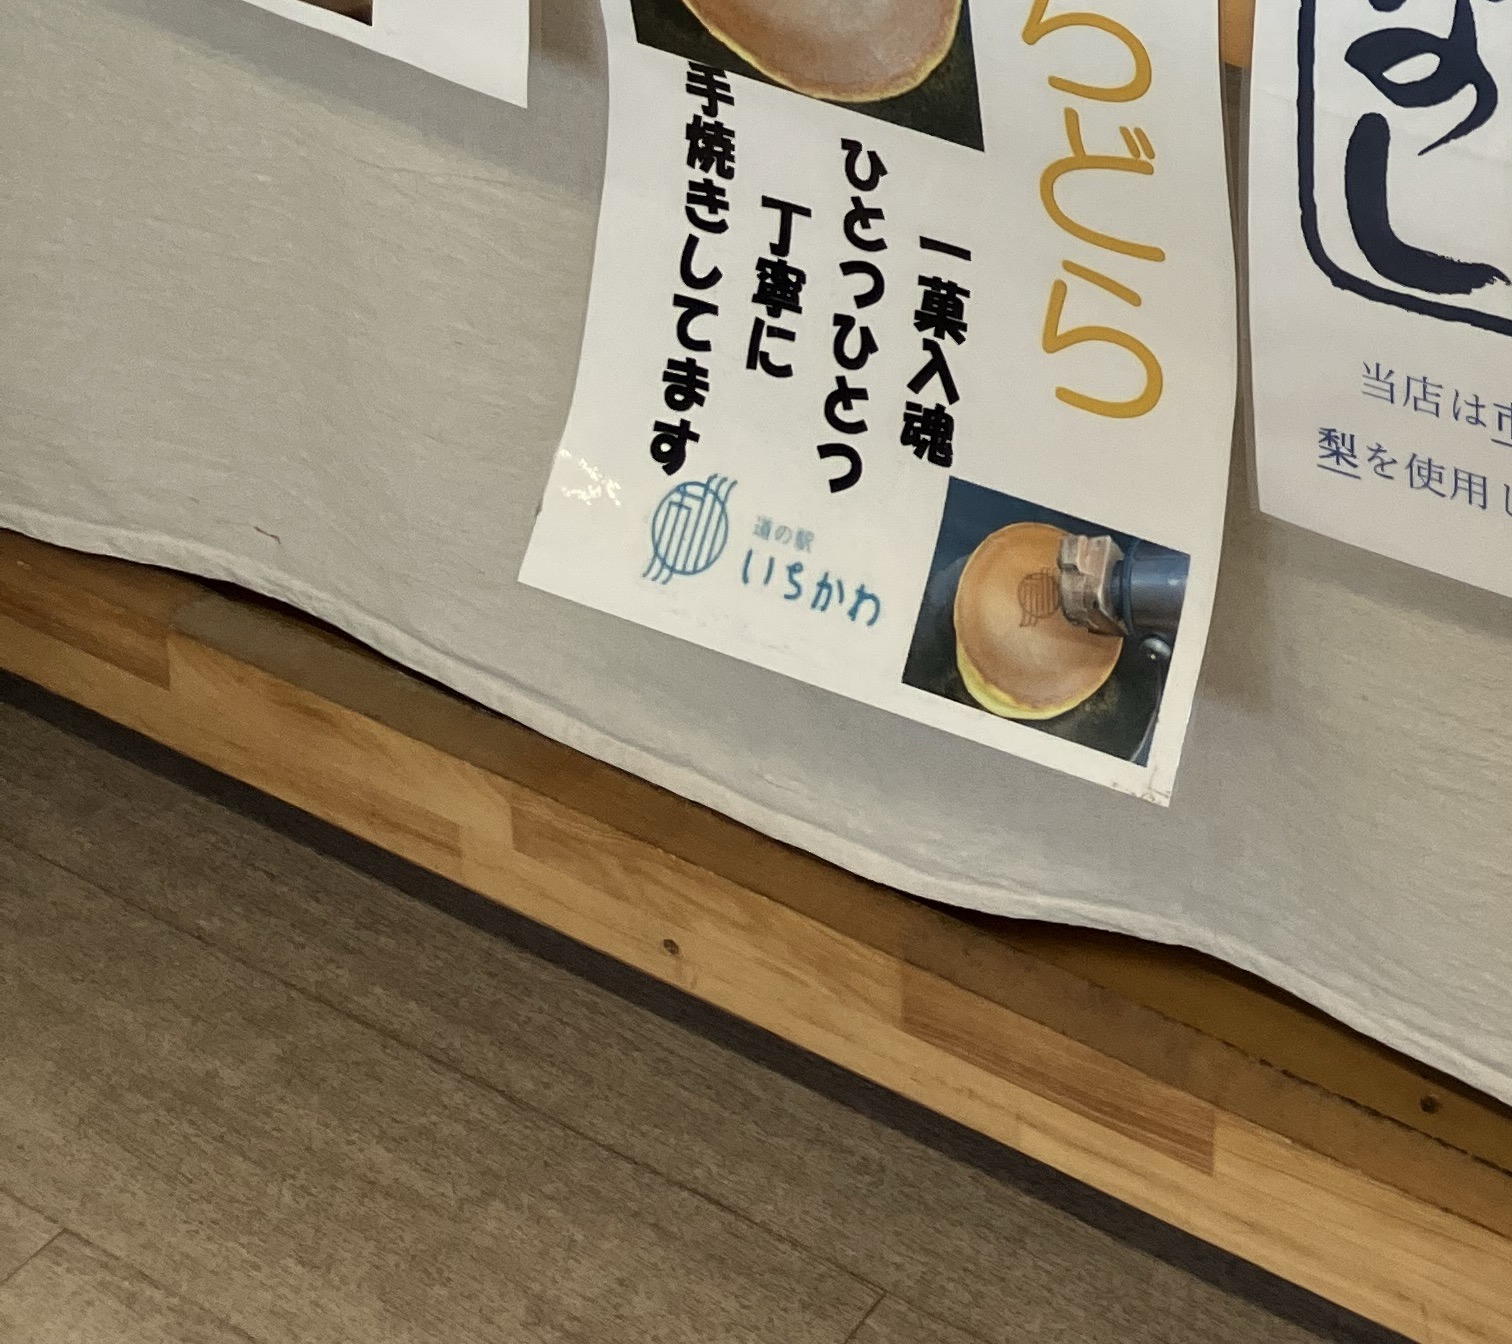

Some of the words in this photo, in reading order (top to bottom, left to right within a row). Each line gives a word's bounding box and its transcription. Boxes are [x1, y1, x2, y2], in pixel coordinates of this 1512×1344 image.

[649, 60, 736, 476] 手焼きしてます
[745, 194, 813, 378] 丁寧に
[816, 137, 889, 494] ひとつひとつ
[899, 235, 973, 468] 一菓入魂
[741, 548, 881, 627] いちかわ
[753, 514, 816, 553] 道の駅
